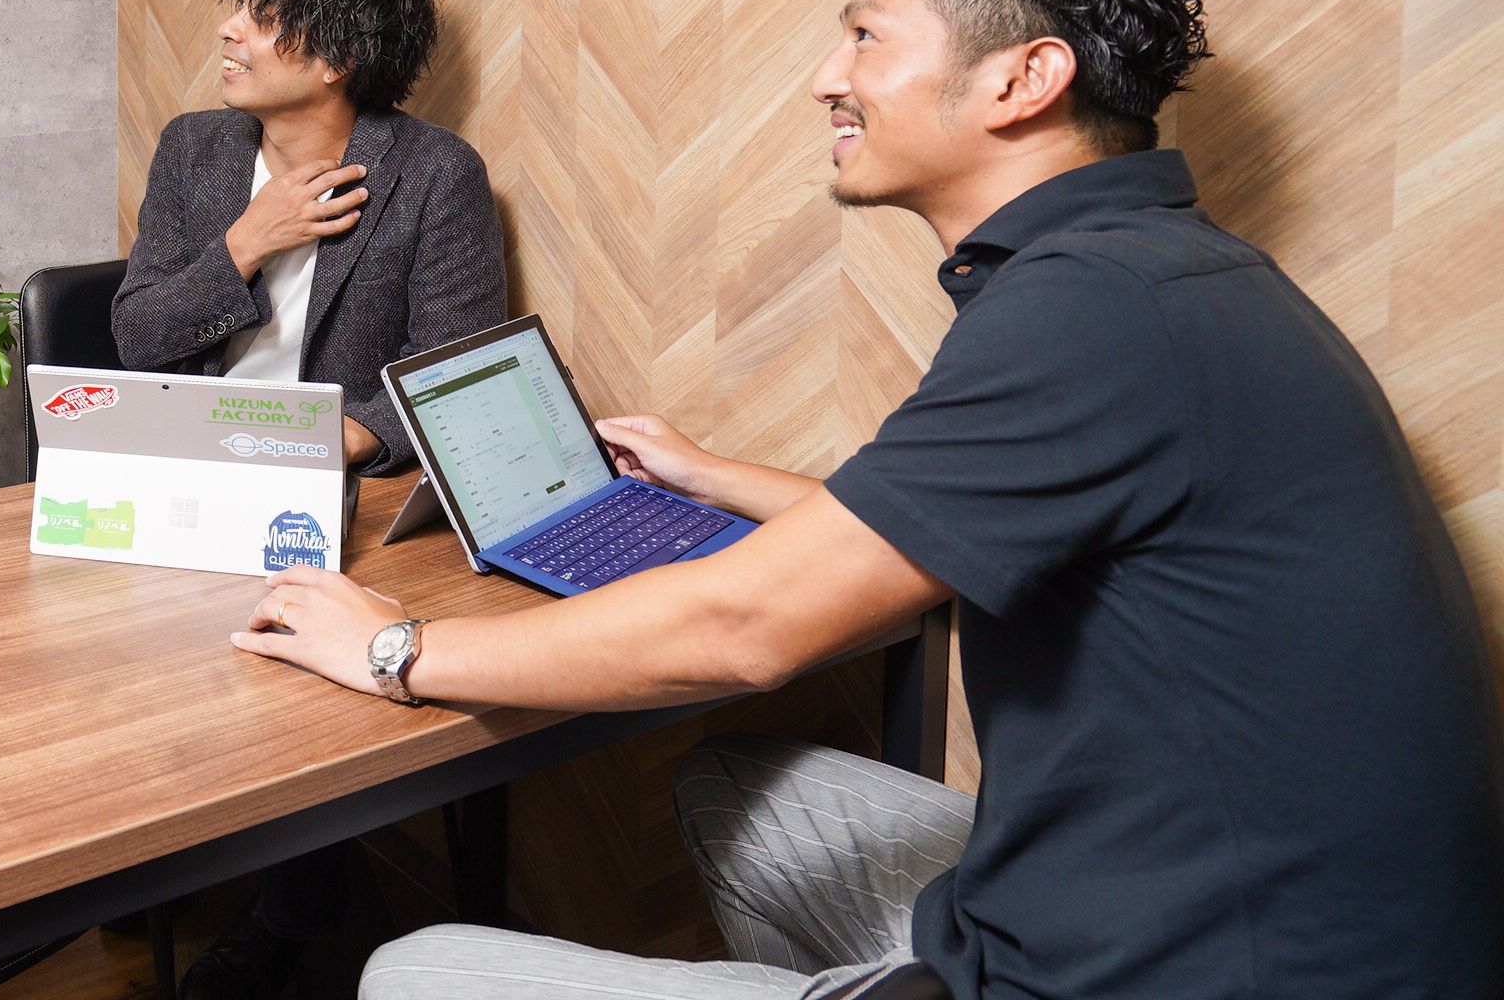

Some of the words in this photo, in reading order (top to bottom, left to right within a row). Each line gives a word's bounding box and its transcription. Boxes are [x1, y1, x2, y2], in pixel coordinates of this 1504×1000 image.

[60, 389, 88, 402] VANS
[69, 395, 94, 410] THE
[219, 397, 286, 412] KIZUNA
[212, 409, 295, 425] FACTORY
[264, 439, 327, 457] Spacee
